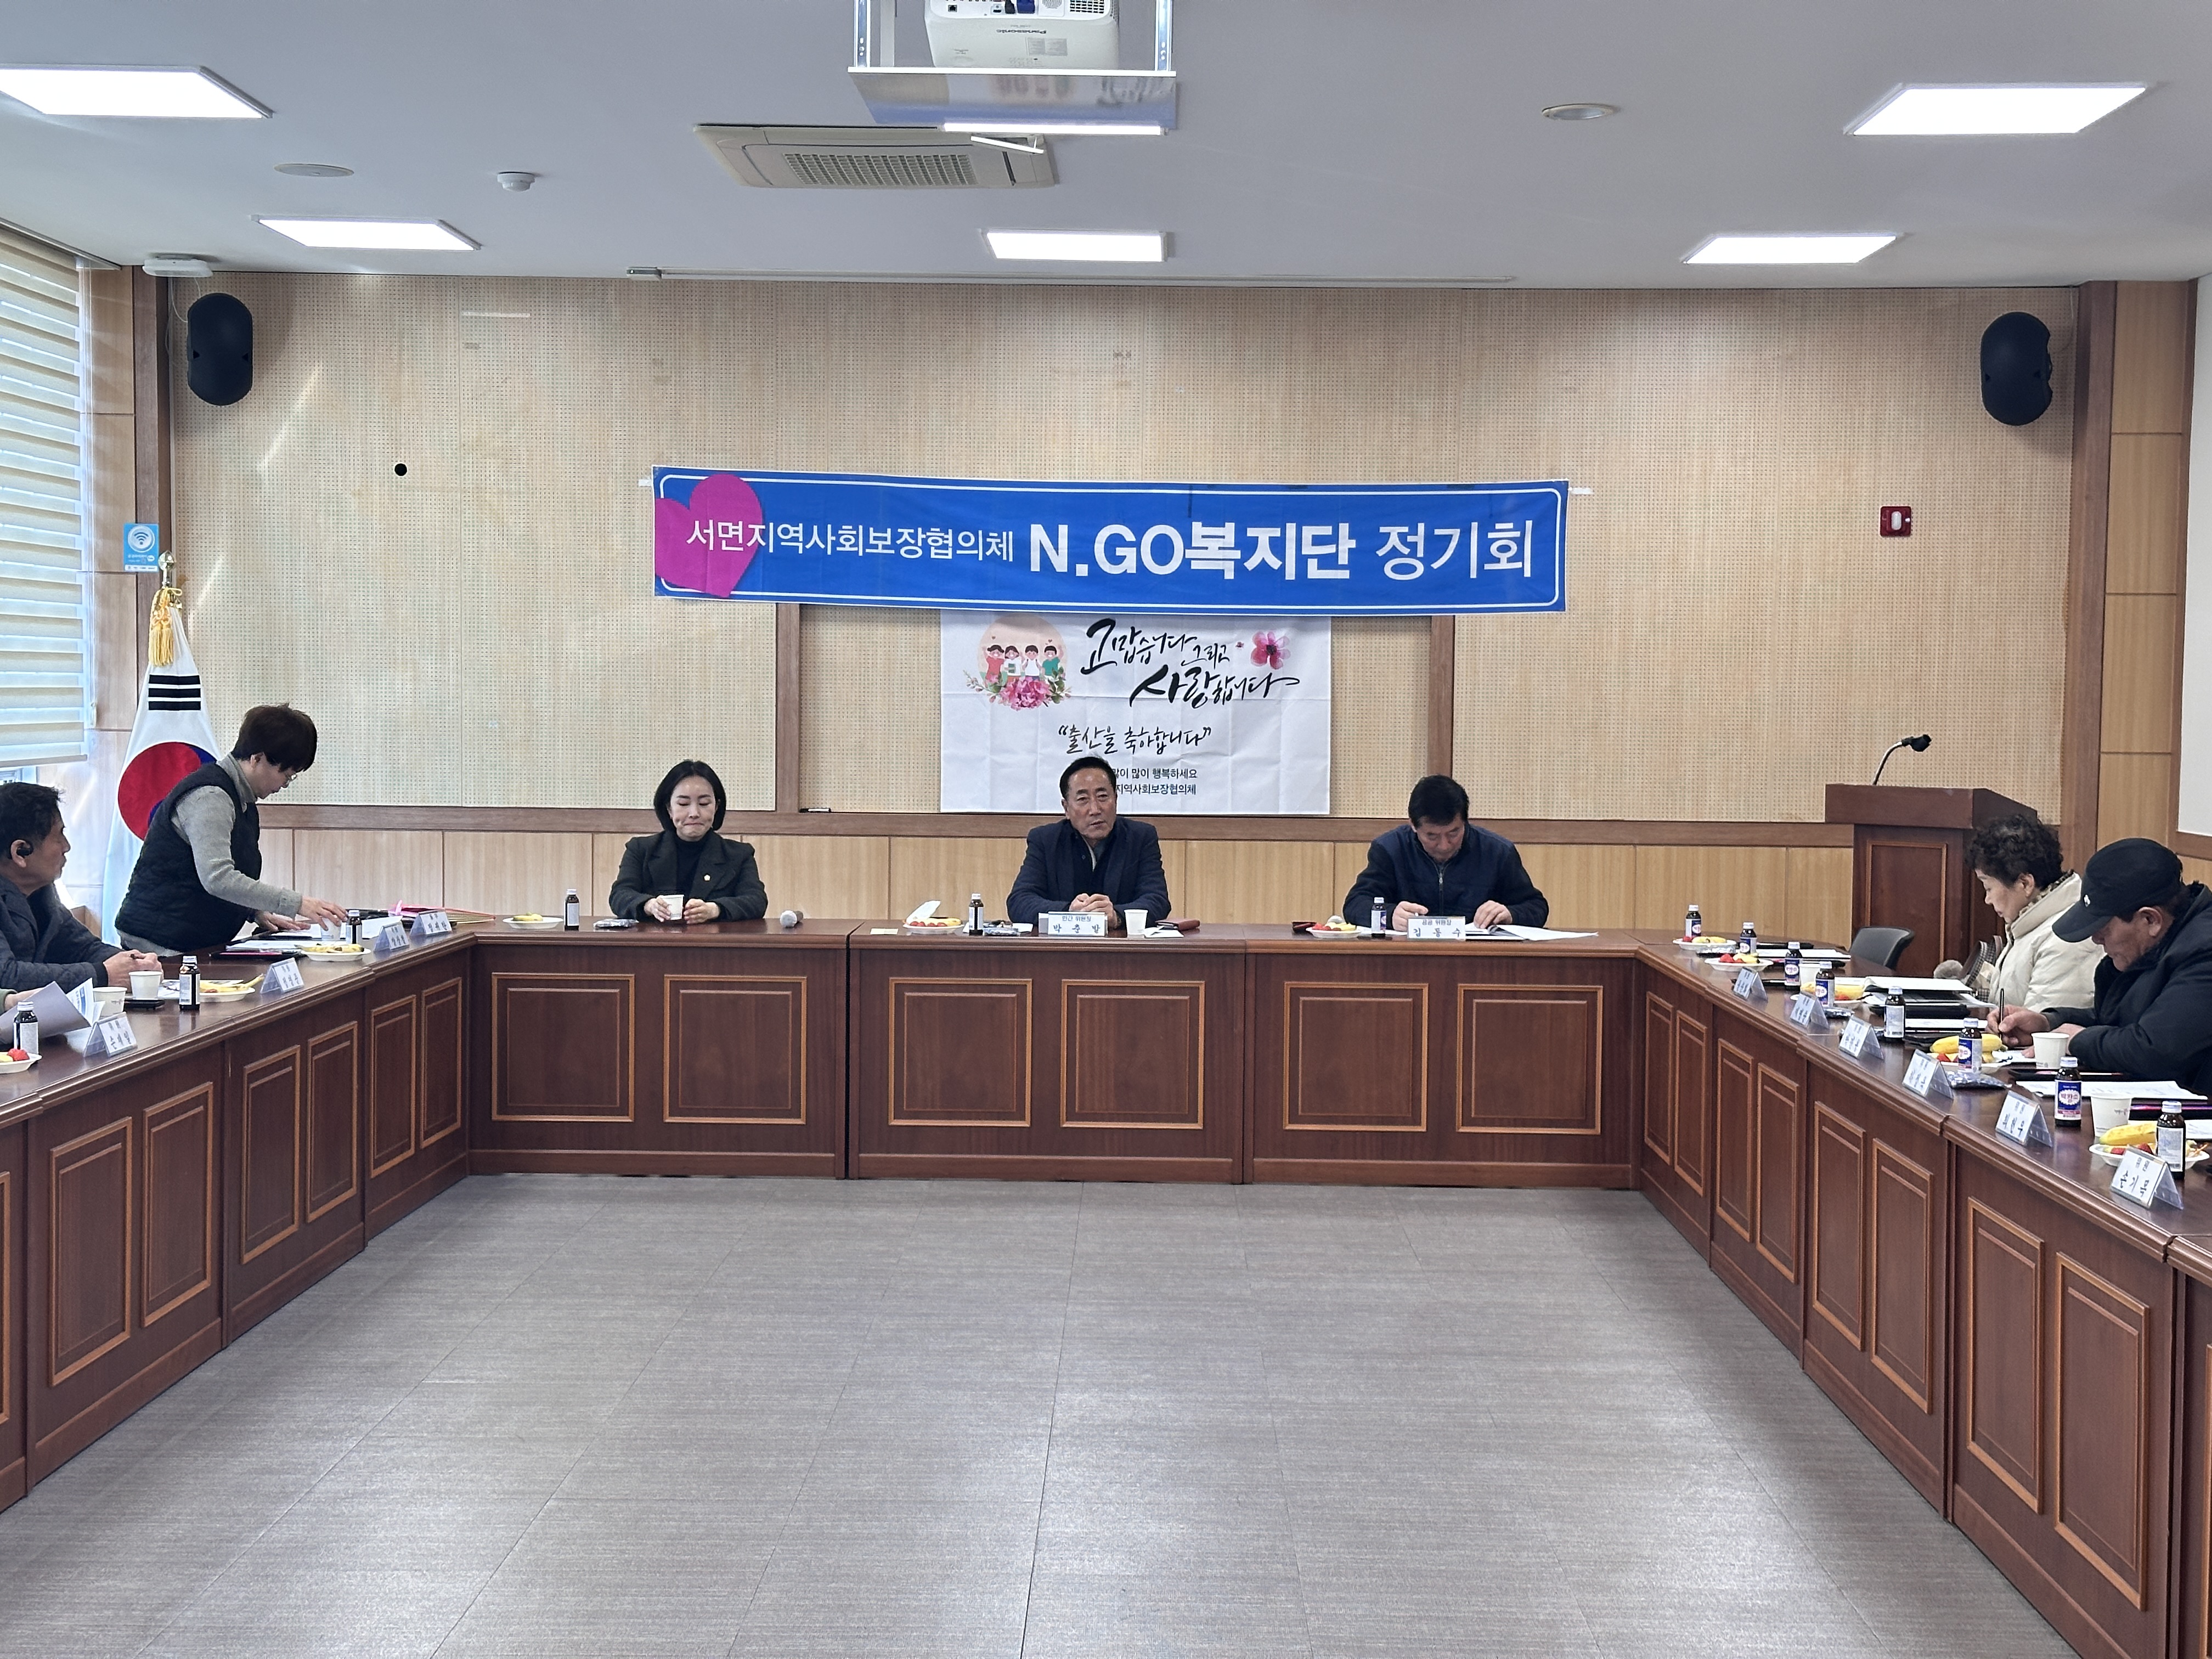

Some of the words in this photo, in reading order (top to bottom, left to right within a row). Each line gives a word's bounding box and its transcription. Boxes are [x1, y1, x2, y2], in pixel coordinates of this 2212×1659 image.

[686, 518, 1014, 562] 서면지역사회보장협의체
[1030, 521, 1356, 580] N.GO복지단
[1375, 519, 1532, 580] 정기회
[1080, 617, 1197, 675] 고맙습니다
[1181, 642, 1230, 670] 그리고
[1130, 664, 1300, 709] 사랑합니다
[1131, 768, 1149, 779] 많이
[1153, 768, 1197, 780] 행복하세요
